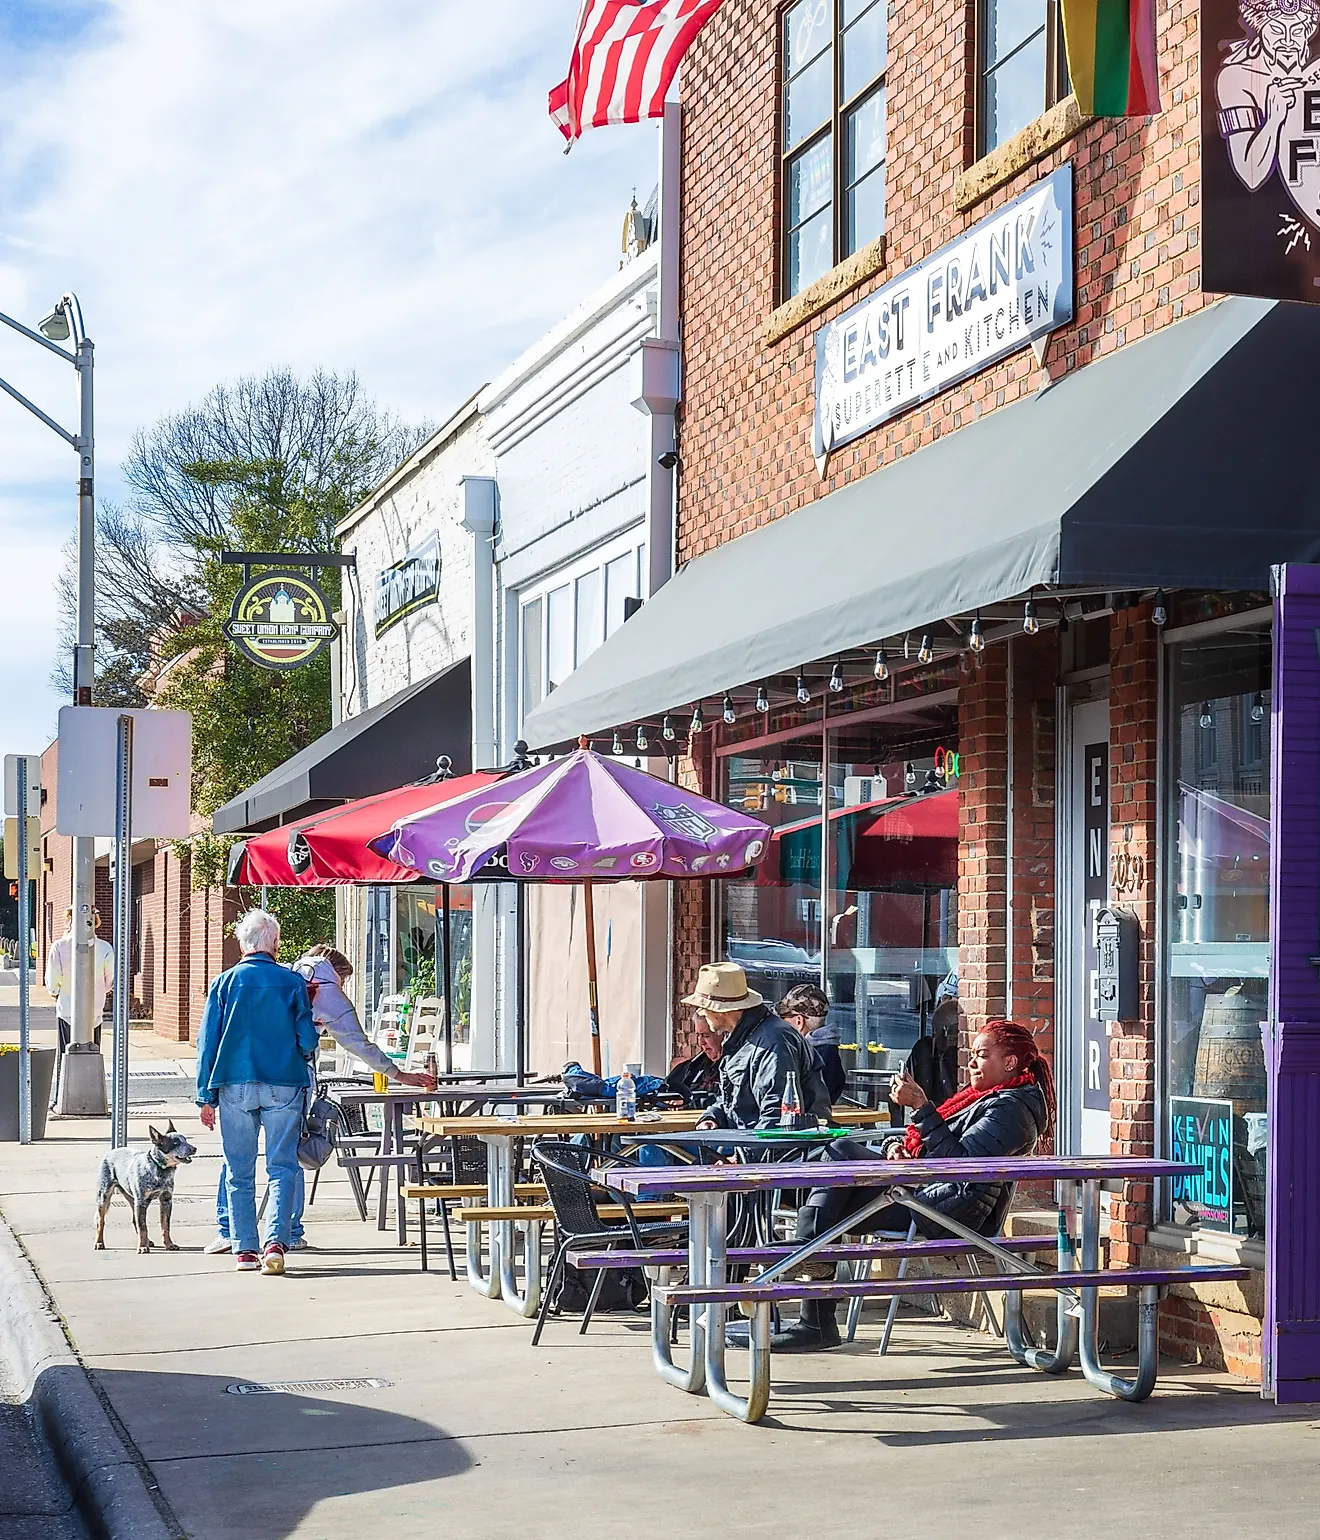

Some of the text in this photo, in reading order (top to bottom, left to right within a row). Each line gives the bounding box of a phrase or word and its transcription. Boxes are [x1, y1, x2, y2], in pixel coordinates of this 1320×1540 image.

[843, 207, 1036, 384] EAST FRANK
[834, 280, 1049, 431] SUPERETTE AND KITCHEN
[257, 624, 279, 635] UNION
[300, 625, 332, 637] COMPANY
[1088, 757, 1102, 1090] ENTER
[1173, 1106, 1229, 1145] KEVIN
[1173, 1142, 1229, 1208] DANIELS
